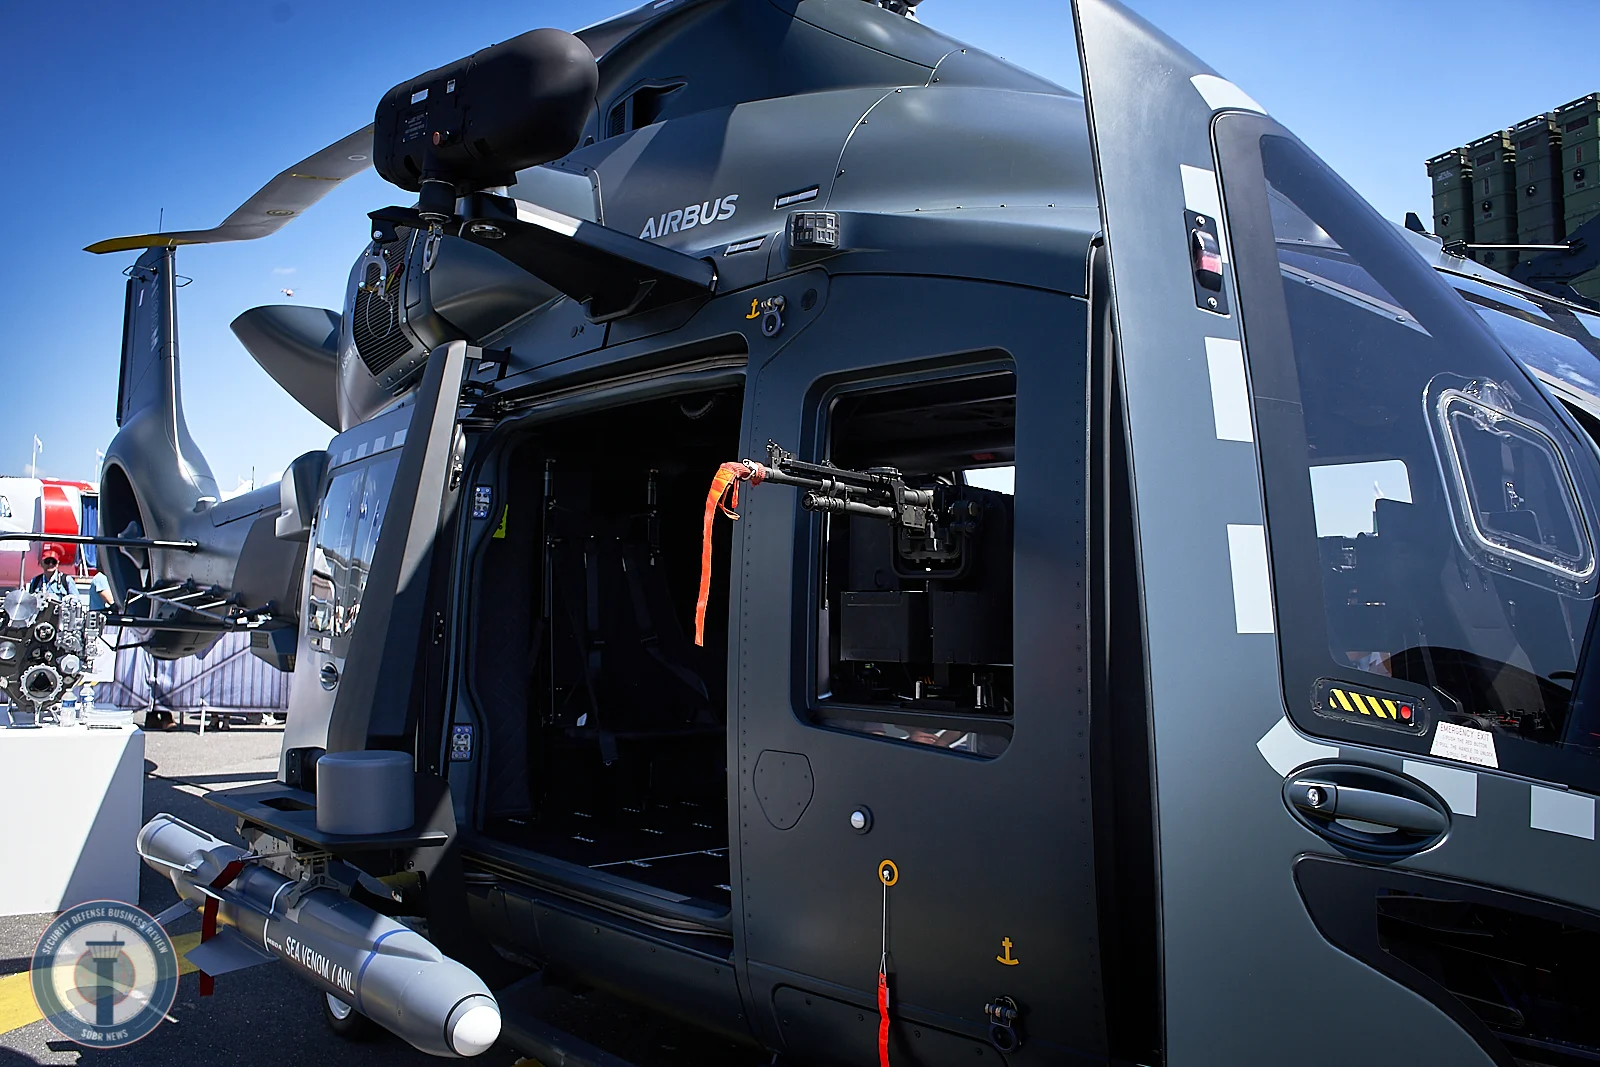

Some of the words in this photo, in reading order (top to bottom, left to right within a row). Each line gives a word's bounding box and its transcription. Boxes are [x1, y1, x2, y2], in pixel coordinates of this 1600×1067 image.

[639, 194, 739, 240] AIRBUS
[1440, 724, 1475, 738] EMERGENCY
[1477, 731, 1490, 741] EXIT
[267, 937, 282, 951] MBDA
[285, 935, 301, 962] SEA
[301, 944, 331, 980] VENOM
[336, 966, 355, 995] ANL
